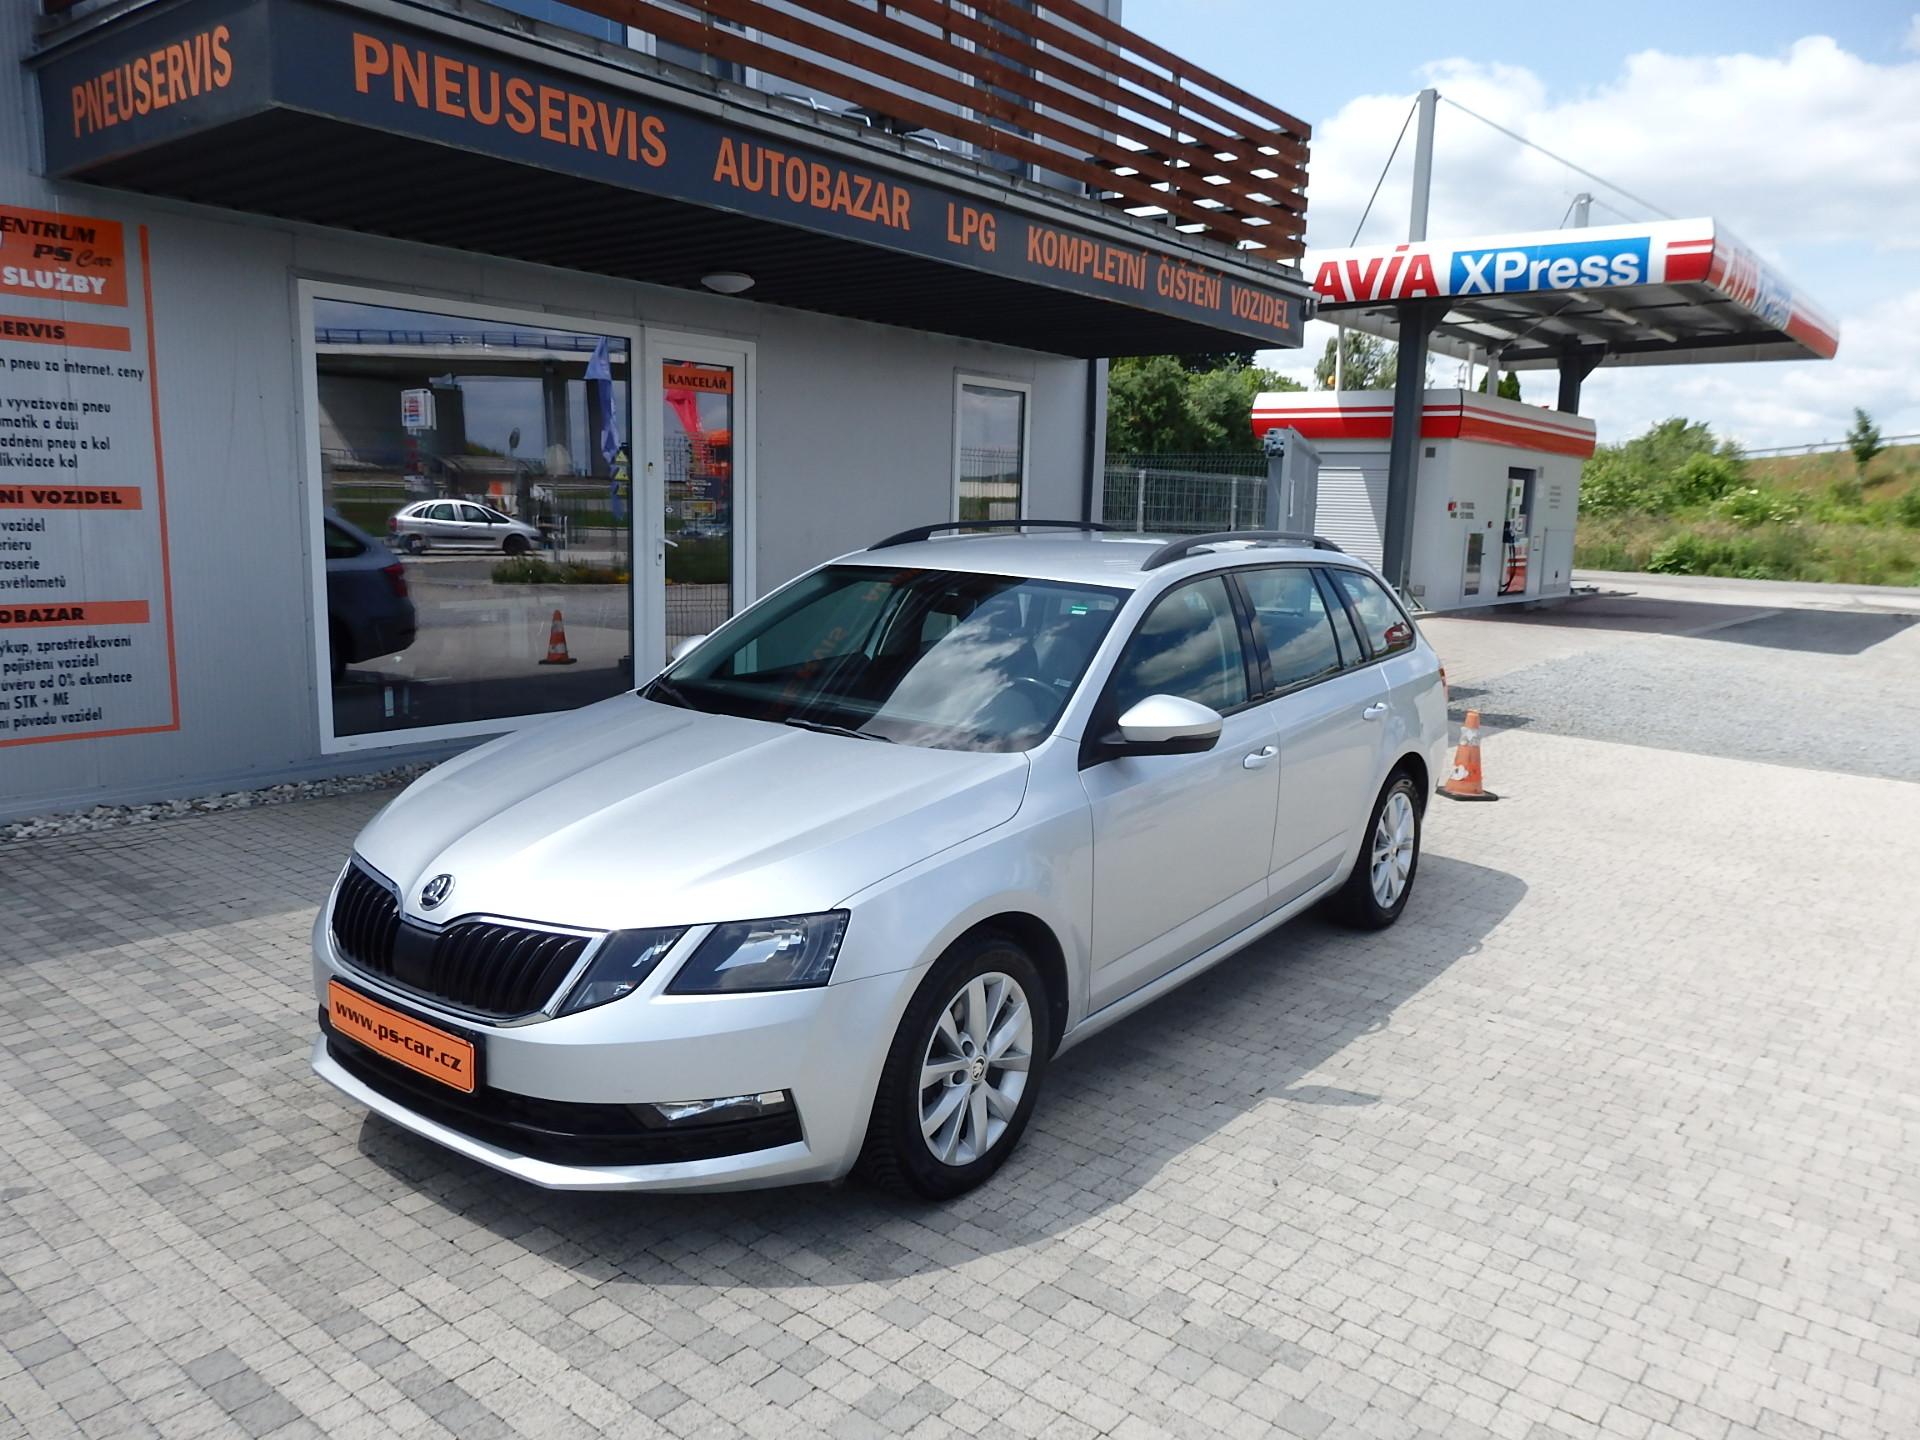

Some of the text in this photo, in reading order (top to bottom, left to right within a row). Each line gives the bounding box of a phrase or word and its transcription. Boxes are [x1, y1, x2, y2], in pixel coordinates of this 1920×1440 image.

[72, 25, 232, 138] PNEUSERVIS
[353, 32, 1289, 329] PNEUSERVIS AUTOBAZAR LPG KOMPLETNÍ ČIŠTĚNÍ VOZIDEL
[0, 216, 96, 243] ENTRUM
[33, 243, 73, 262] PS
[3, 266, 107, 295] SLUŽBY
[1459, 253, 1640, 295] XPress
[10, 359, 40, 372] pneu
[45, 361, 59, 371] za
[64, 358, 114, 376] internet.
[117, 367, 144, 381] ceny
[668, 373, 727, 389] KANCELÁŘ
[82, 402, 111, 415] pneu
[43, 420, 51, 429] a
[47, 439, 76, 452] pneu
[81, 440, 88, 450] a
[91, 436, 110, 450] kol
[59, 453, 78, 469] kol
[31, 490, 122, 504] VOZIDEL
[1, 517, 45, 532] vozidel
[0, 607, 84, 623] OBAZAR
[57, 653, 99, 669] vozidel
[40, 674, 54, 688] od
[58, 673, 75, 687] 0%
[80, 671, 132, 685] akontace
[14, 694, 38, 709] STK
[53, 692, 69, 706] ME
[61, 707, 102, 723] vozidel
[335, 1001, 462, 1073] www.ps-car.cz
